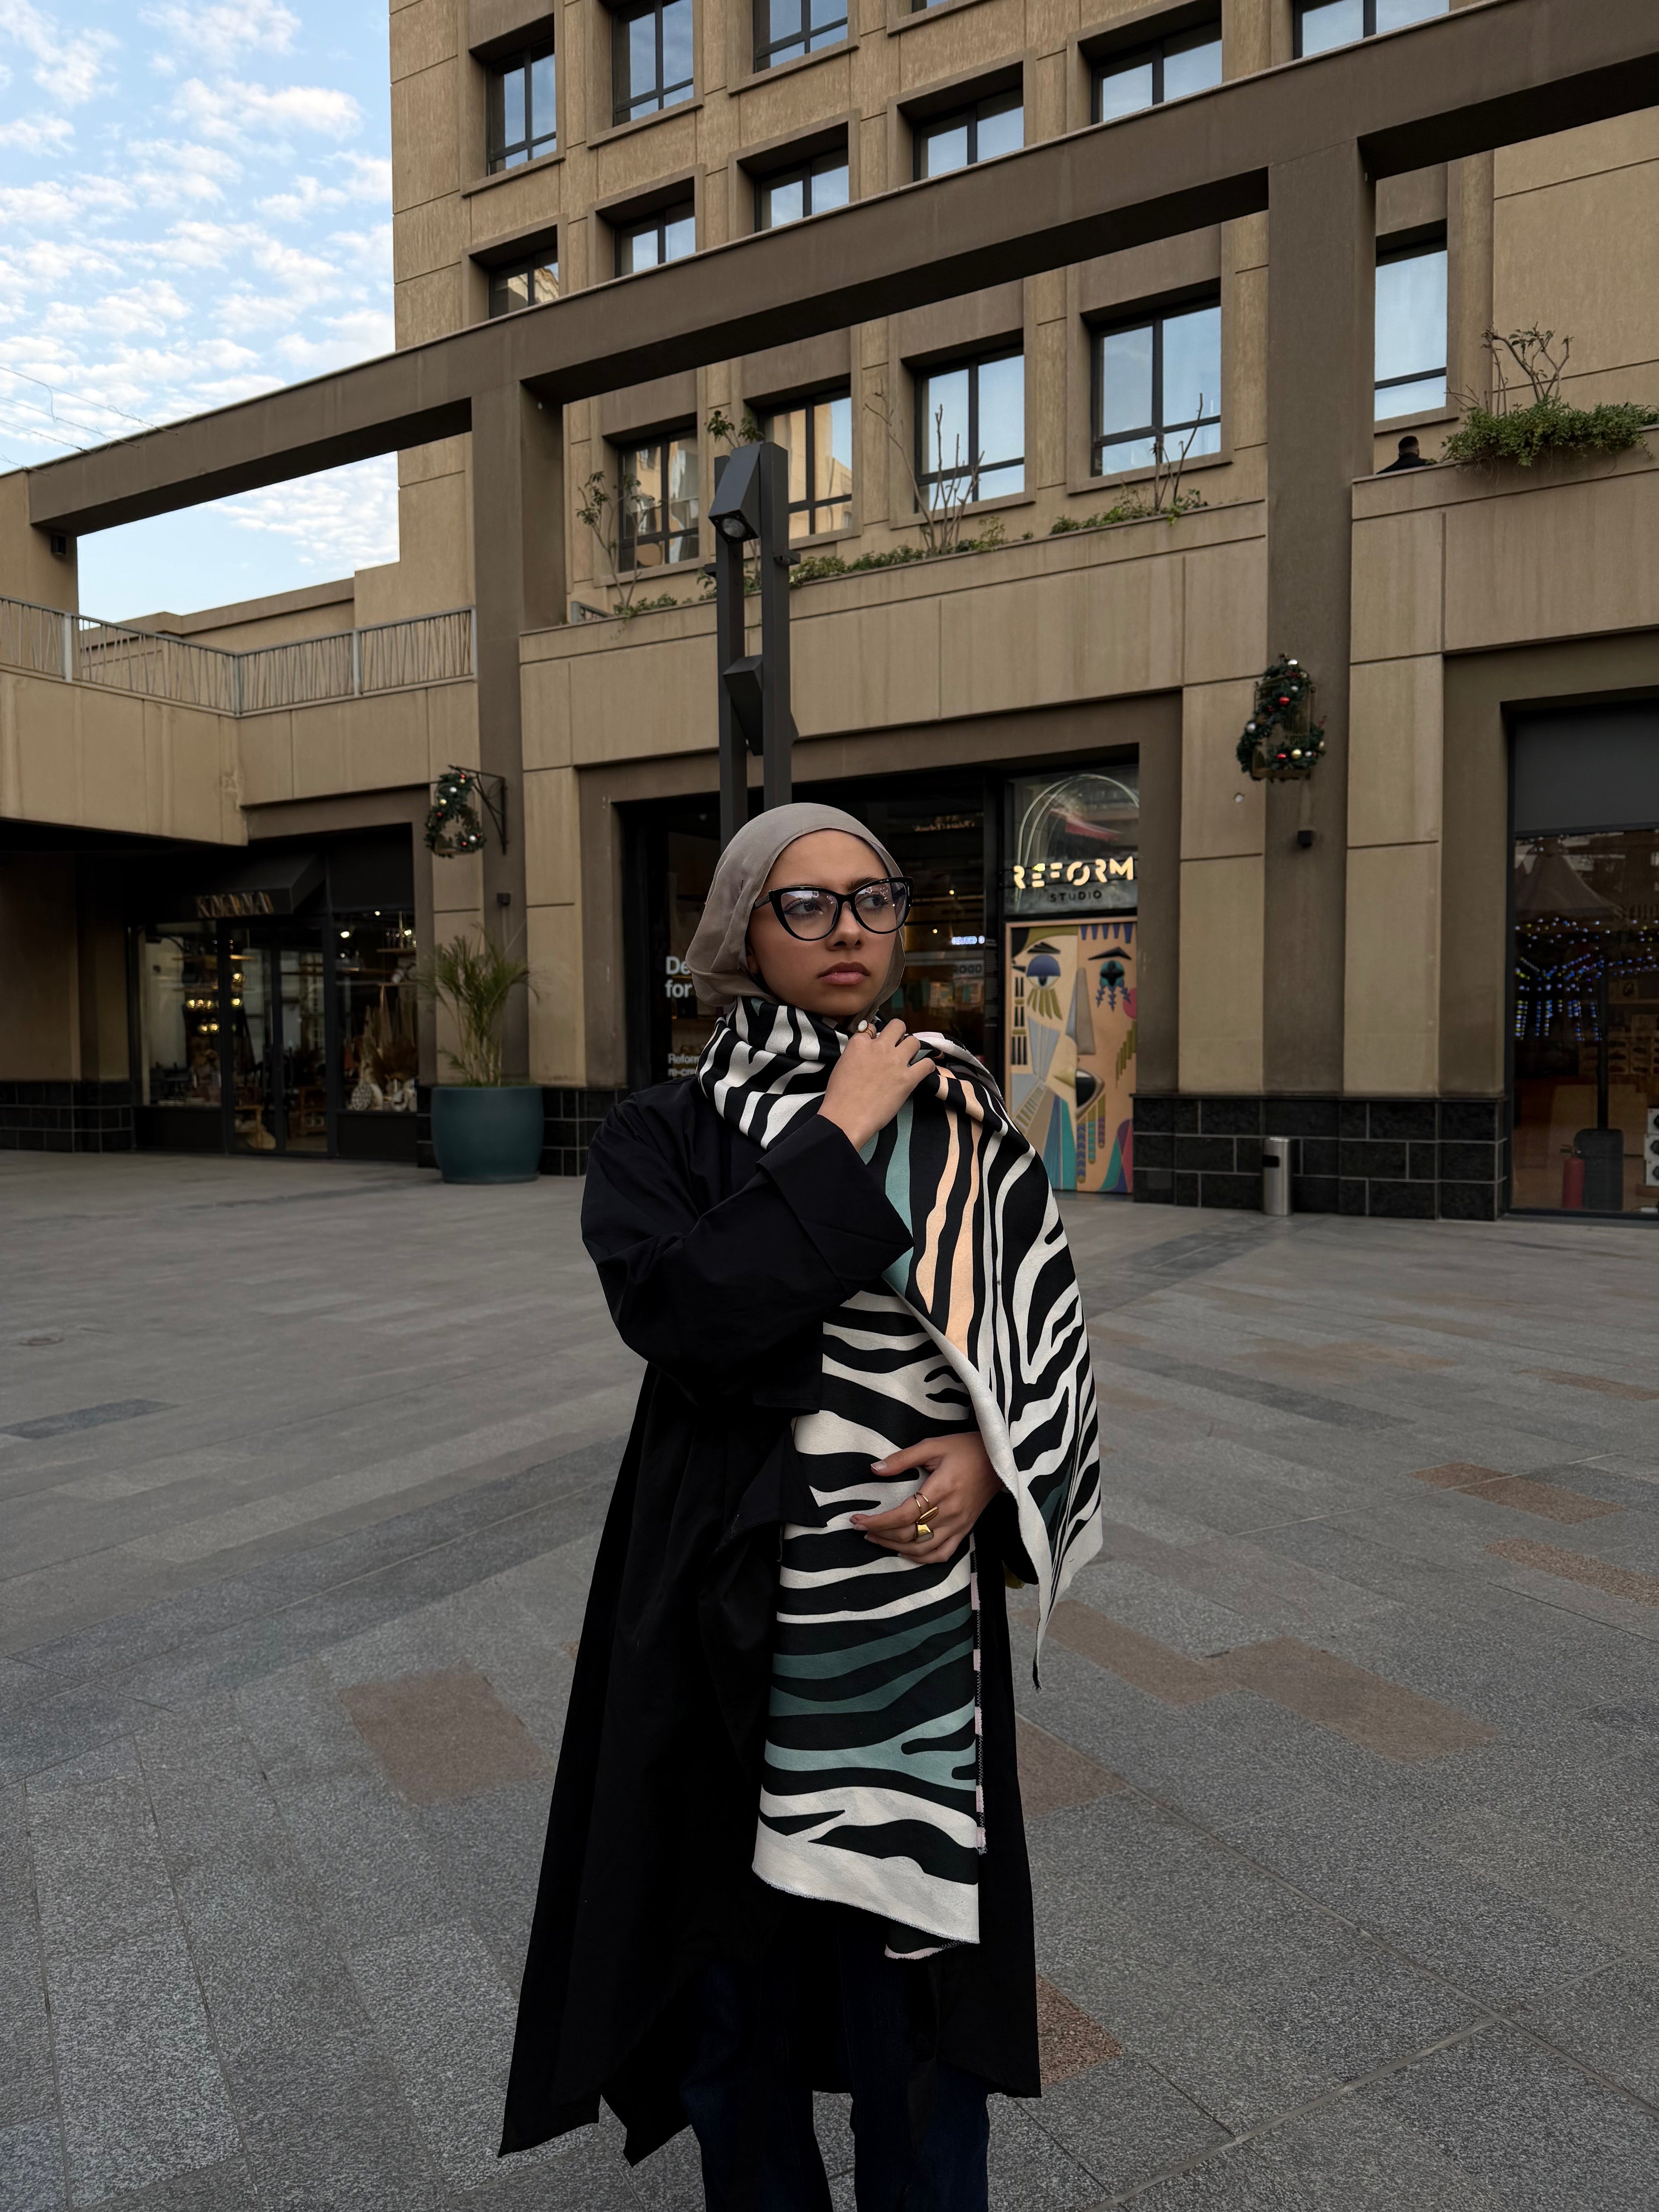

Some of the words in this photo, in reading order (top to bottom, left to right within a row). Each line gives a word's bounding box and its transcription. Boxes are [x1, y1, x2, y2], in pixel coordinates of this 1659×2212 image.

[1013, 856, 1134, 890] REFORM
[1050, 890, 1102, 902] STUDIO
[664, 979, 693, 998] for
